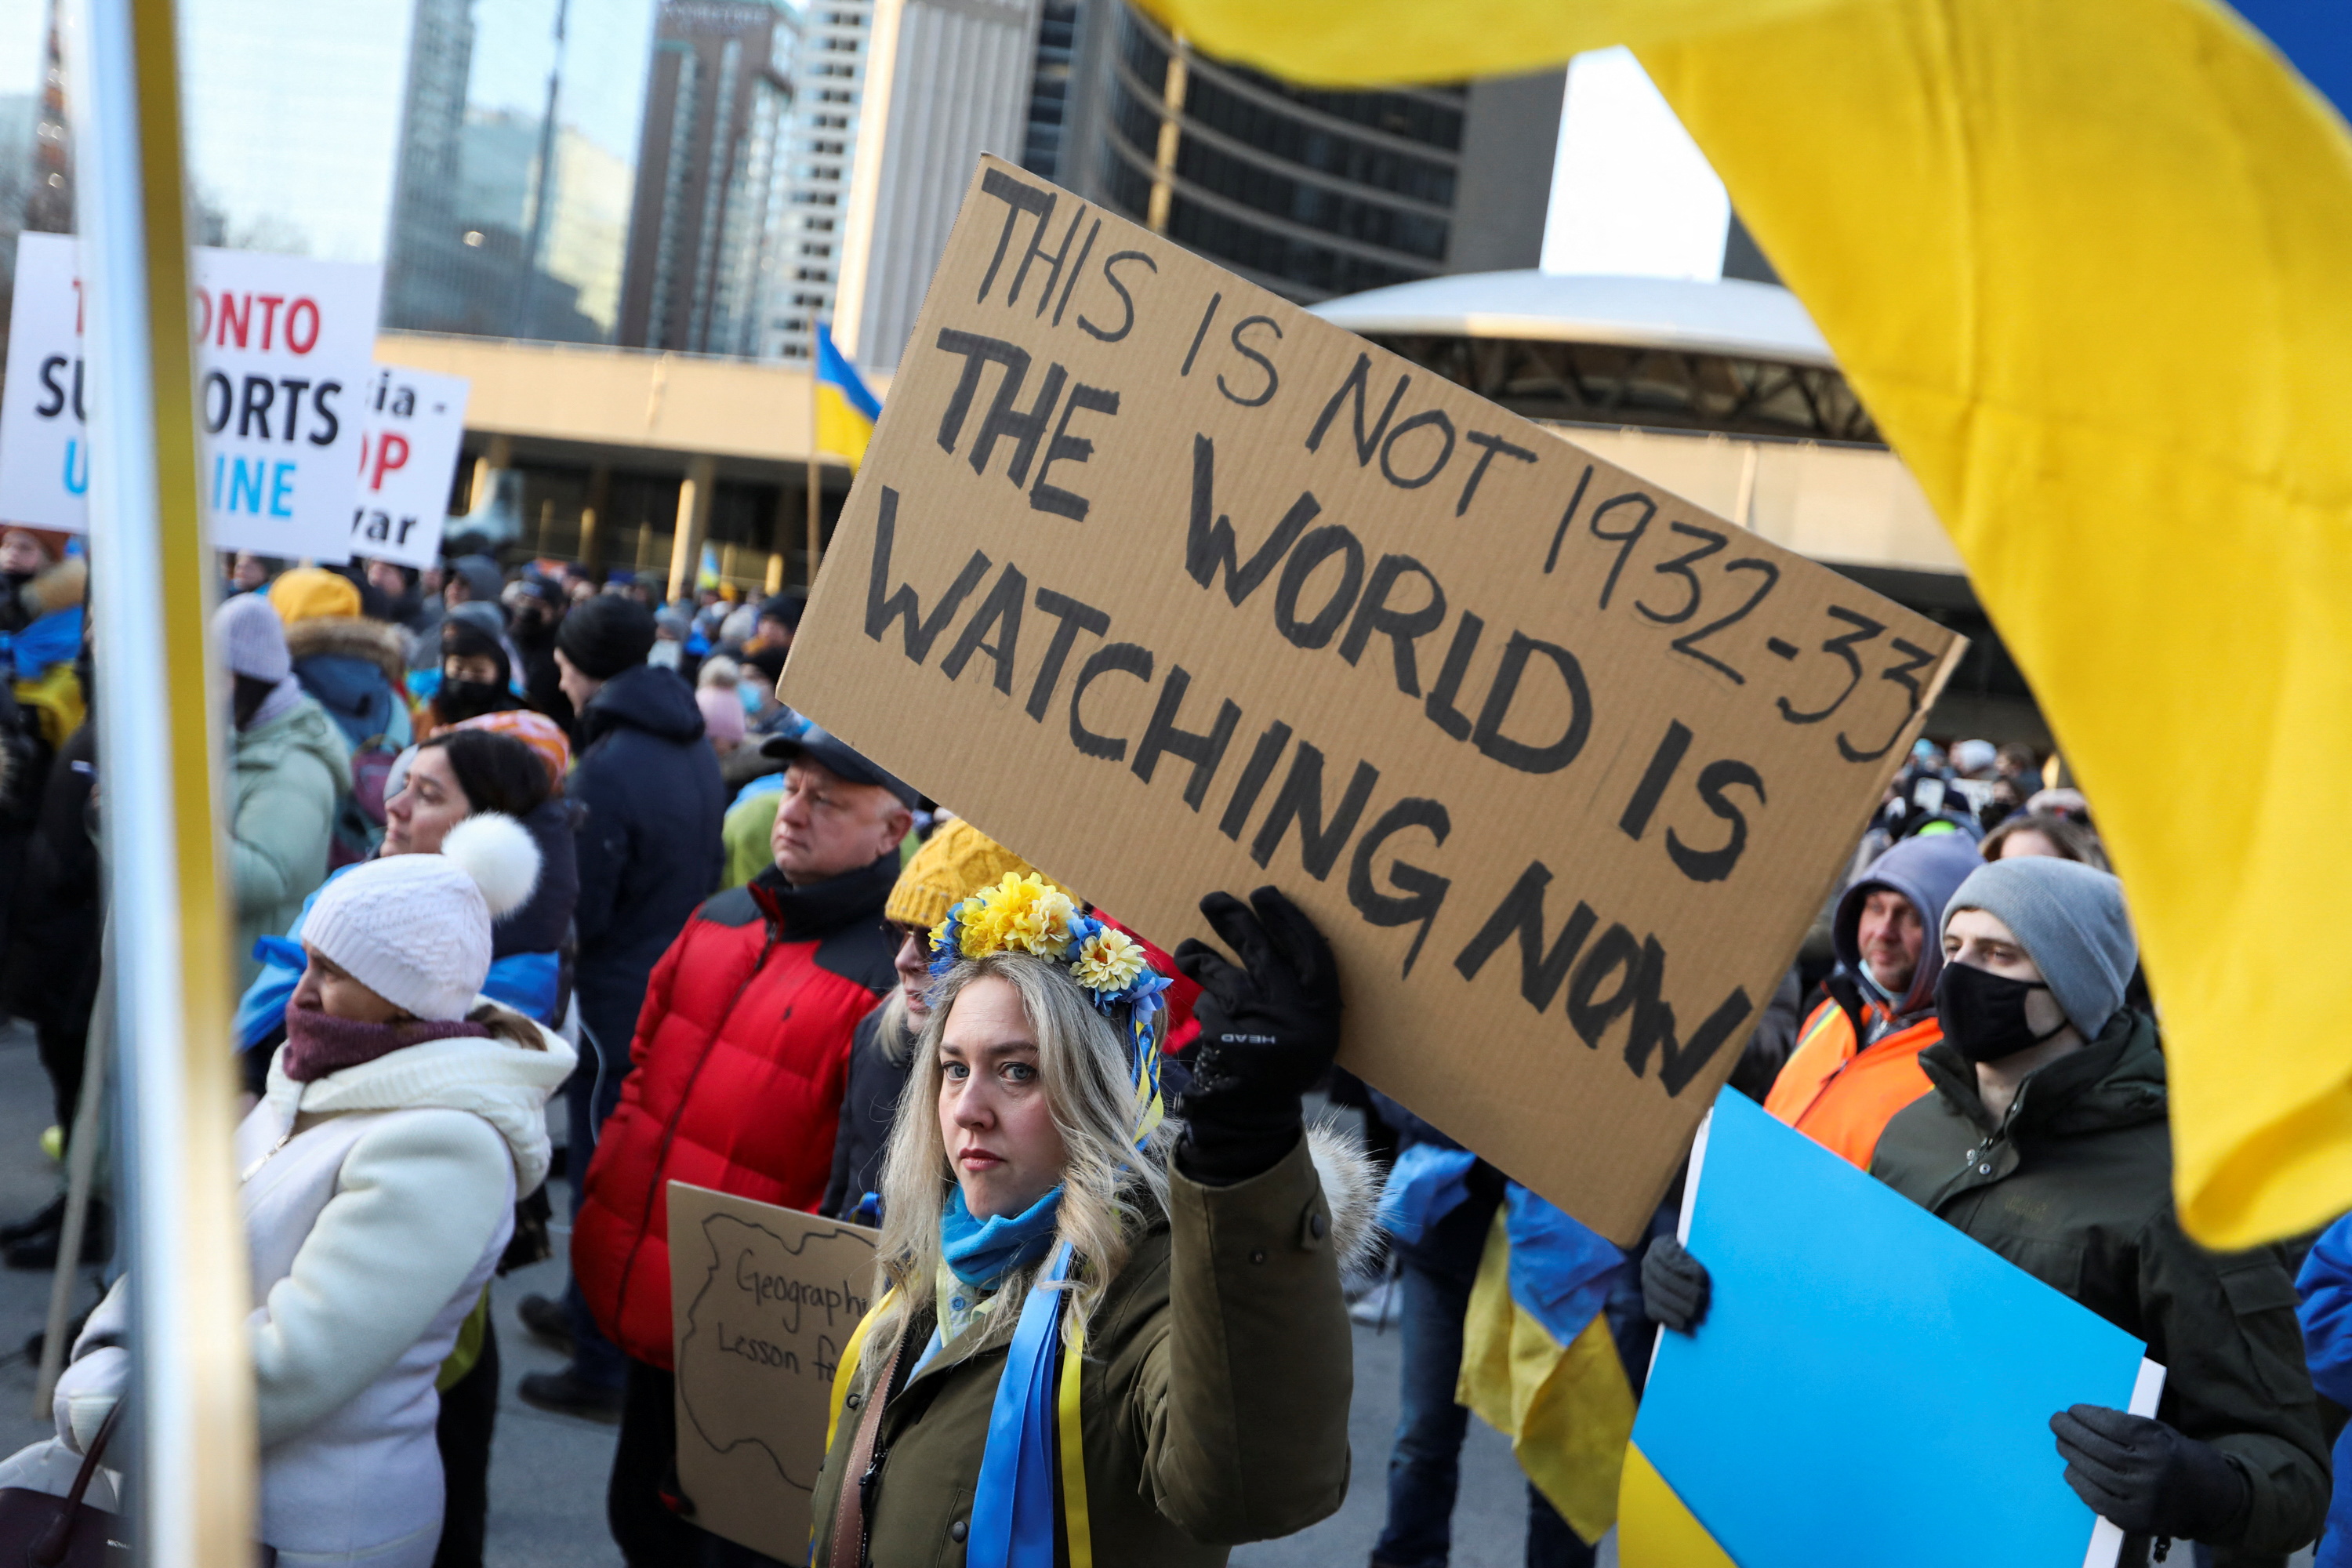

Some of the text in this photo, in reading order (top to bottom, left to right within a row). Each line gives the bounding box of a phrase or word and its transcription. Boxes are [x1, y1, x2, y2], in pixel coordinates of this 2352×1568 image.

[71, 278, 321, 355] TONTO
[35, 355, 343, 447] SUORTS
[62, 437, 296, 518] UINE
[977, 167, 1936, 763] THIS IS NOT 1932-33
[935, 326, 1766, 883] THE WORLD IS
[864, 485, 1453, 981] WATCHING
[1454, 860, 1754, 1098] NOW
[1221, 1033, 1276, 1044] HEAD
[717, 1321, 800, 1374] Lesson
